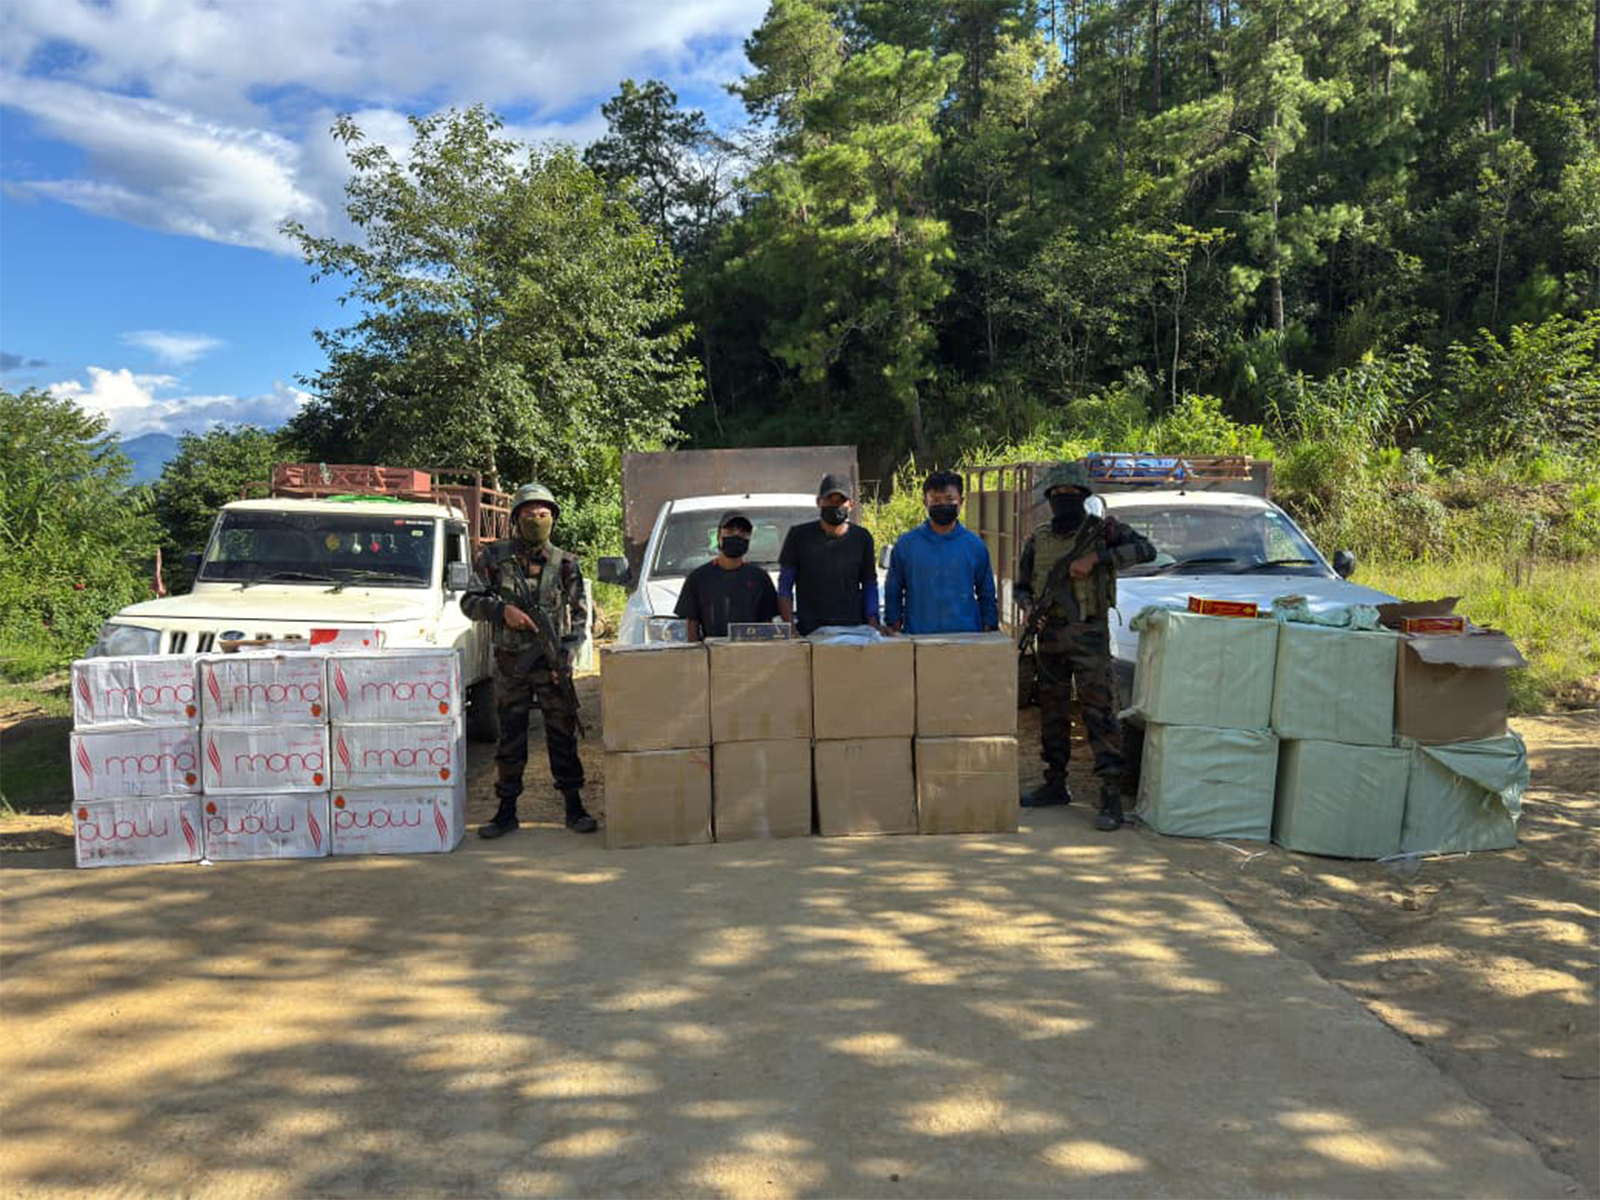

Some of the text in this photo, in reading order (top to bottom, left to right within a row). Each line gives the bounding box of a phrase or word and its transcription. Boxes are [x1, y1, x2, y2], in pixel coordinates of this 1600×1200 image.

[234, 678, 322, 703] mond
[361, 676, 450, 702] mond
[105, 747, 197, 776] mond
[234, 746, 324, 773] mond
[363, 741, 450, 768] mond
[334, 808, 421, 836] mond
